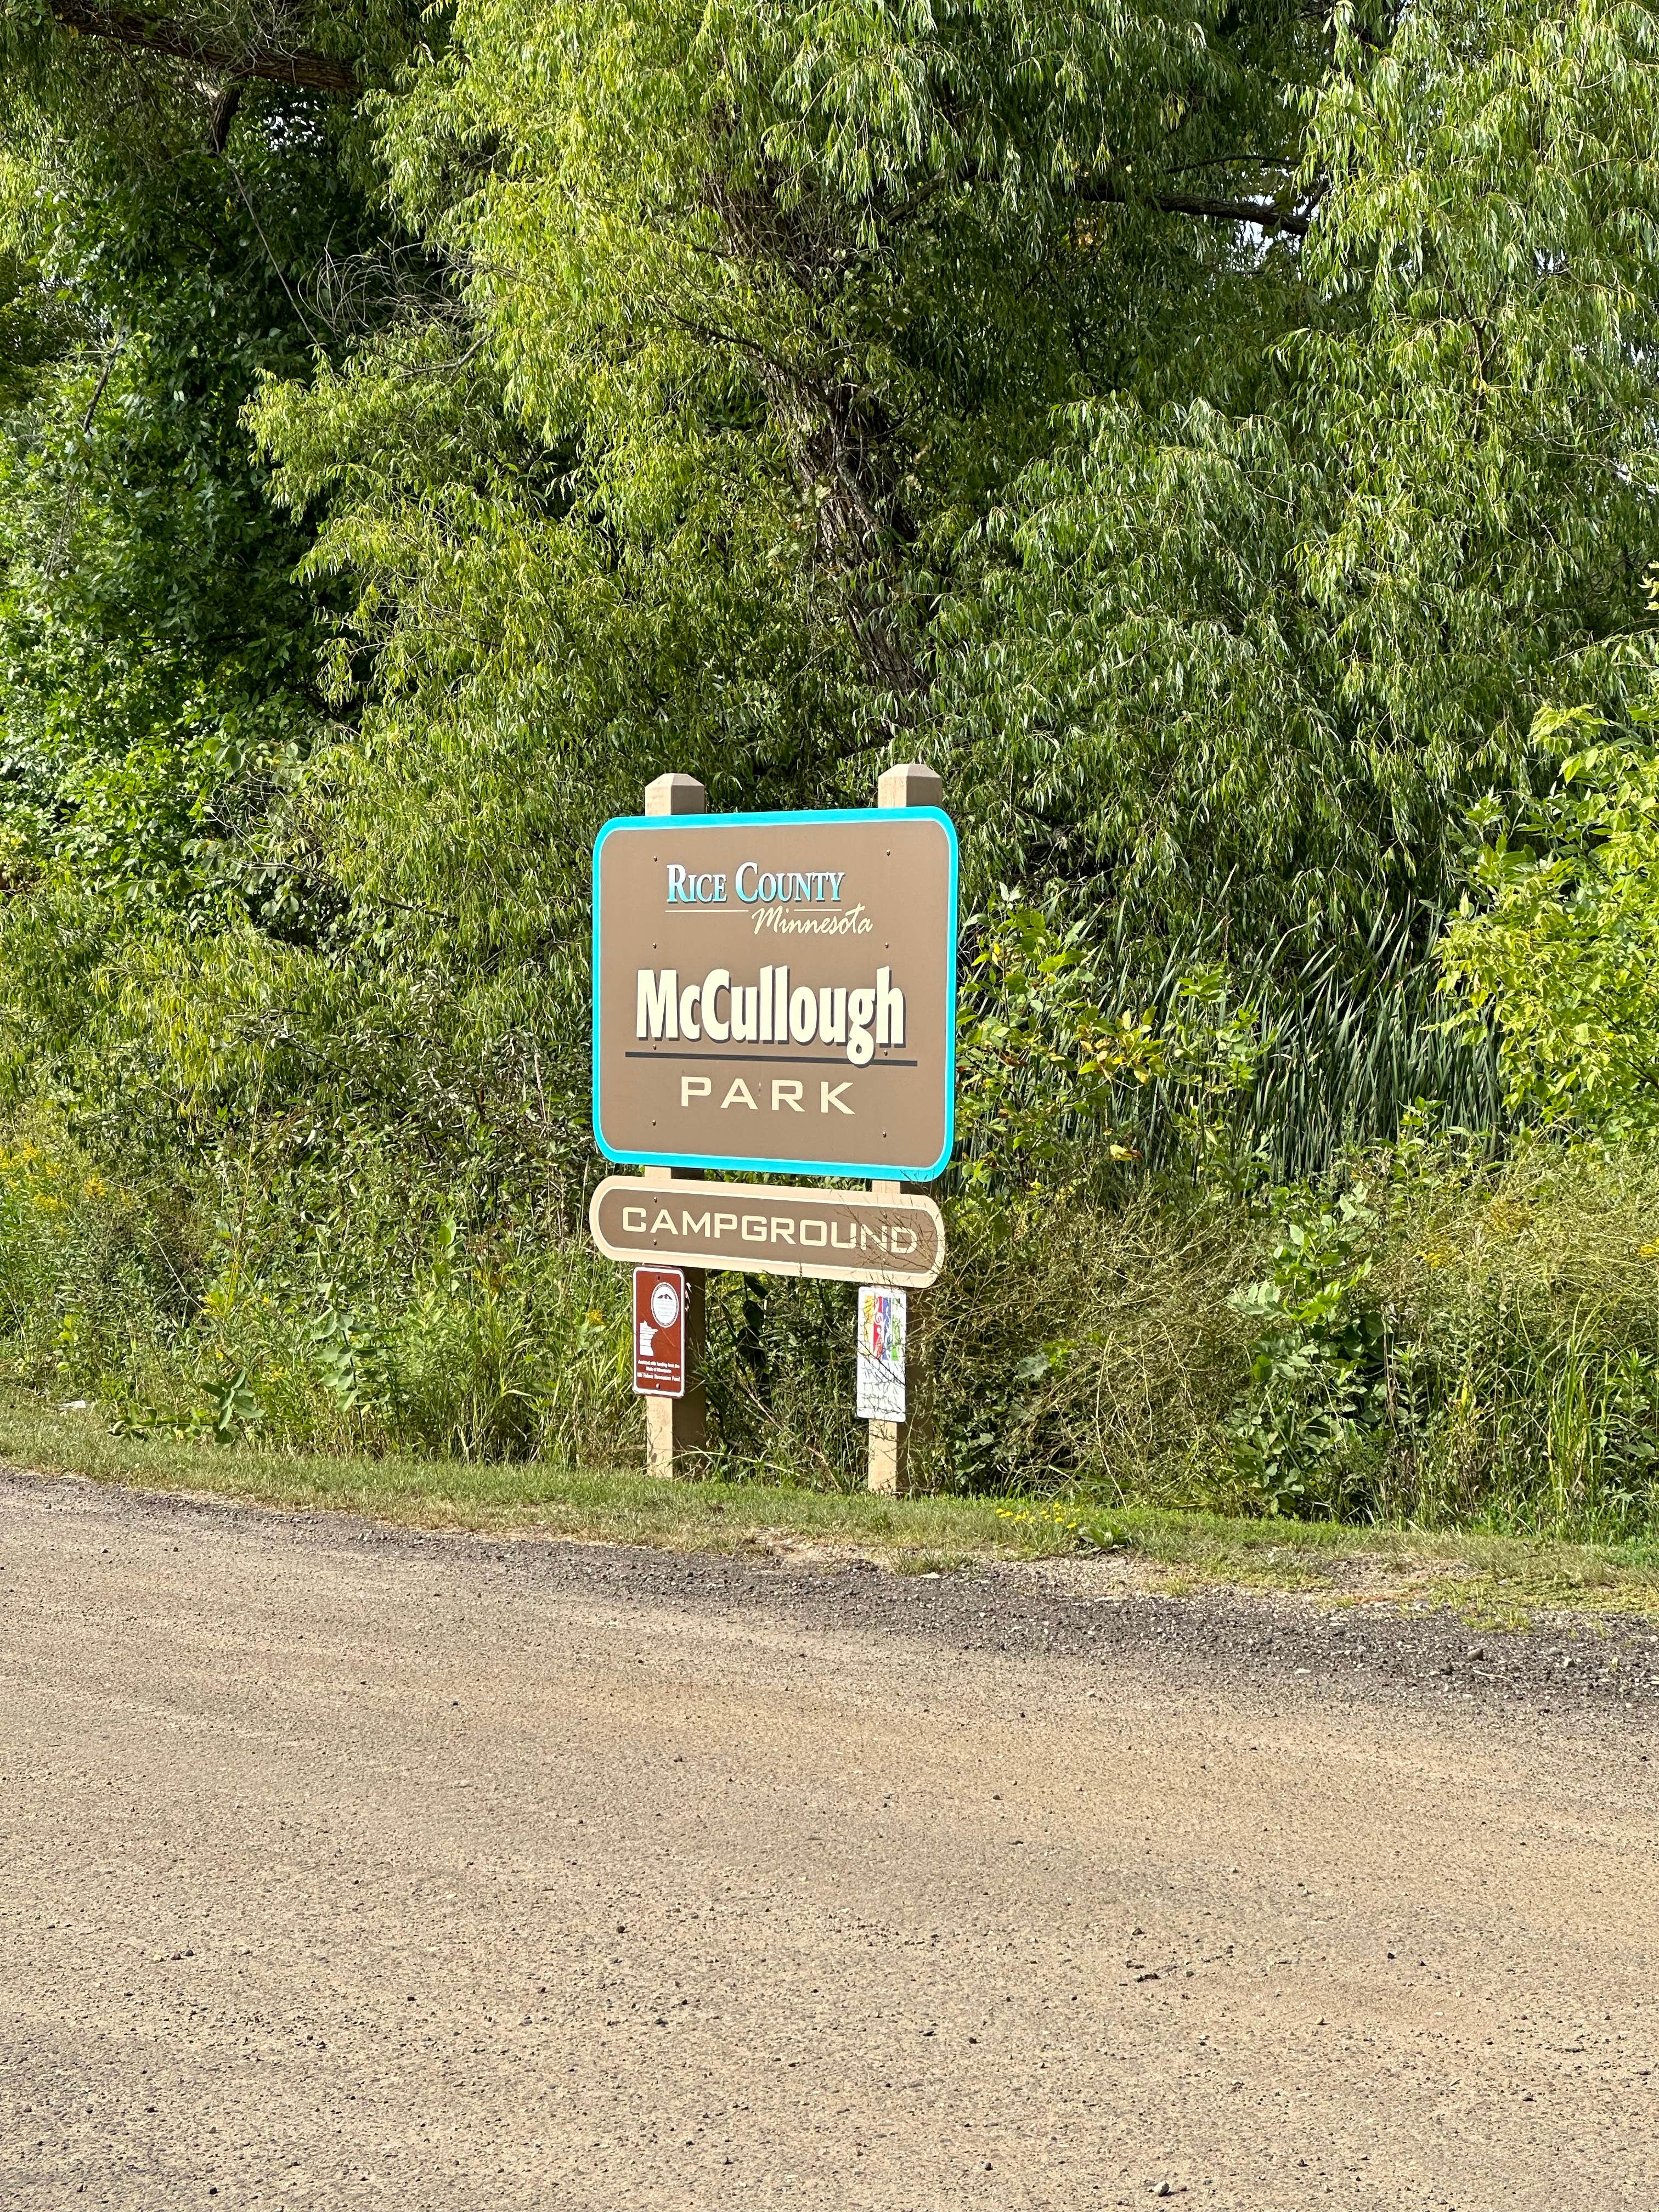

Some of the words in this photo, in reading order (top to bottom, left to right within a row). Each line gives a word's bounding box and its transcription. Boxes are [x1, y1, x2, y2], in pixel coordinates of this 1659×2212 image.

[667, 864, 727, 903] RICE
[735, 862, 845, 903] COUNTY
[751, 902, 873, 935] Minnesota
[636, 964, 905, 1065] McCullough
[681, 1076, 855, 1114] PARK
[622, 1206, 917, 1254] CAMPGROUND
